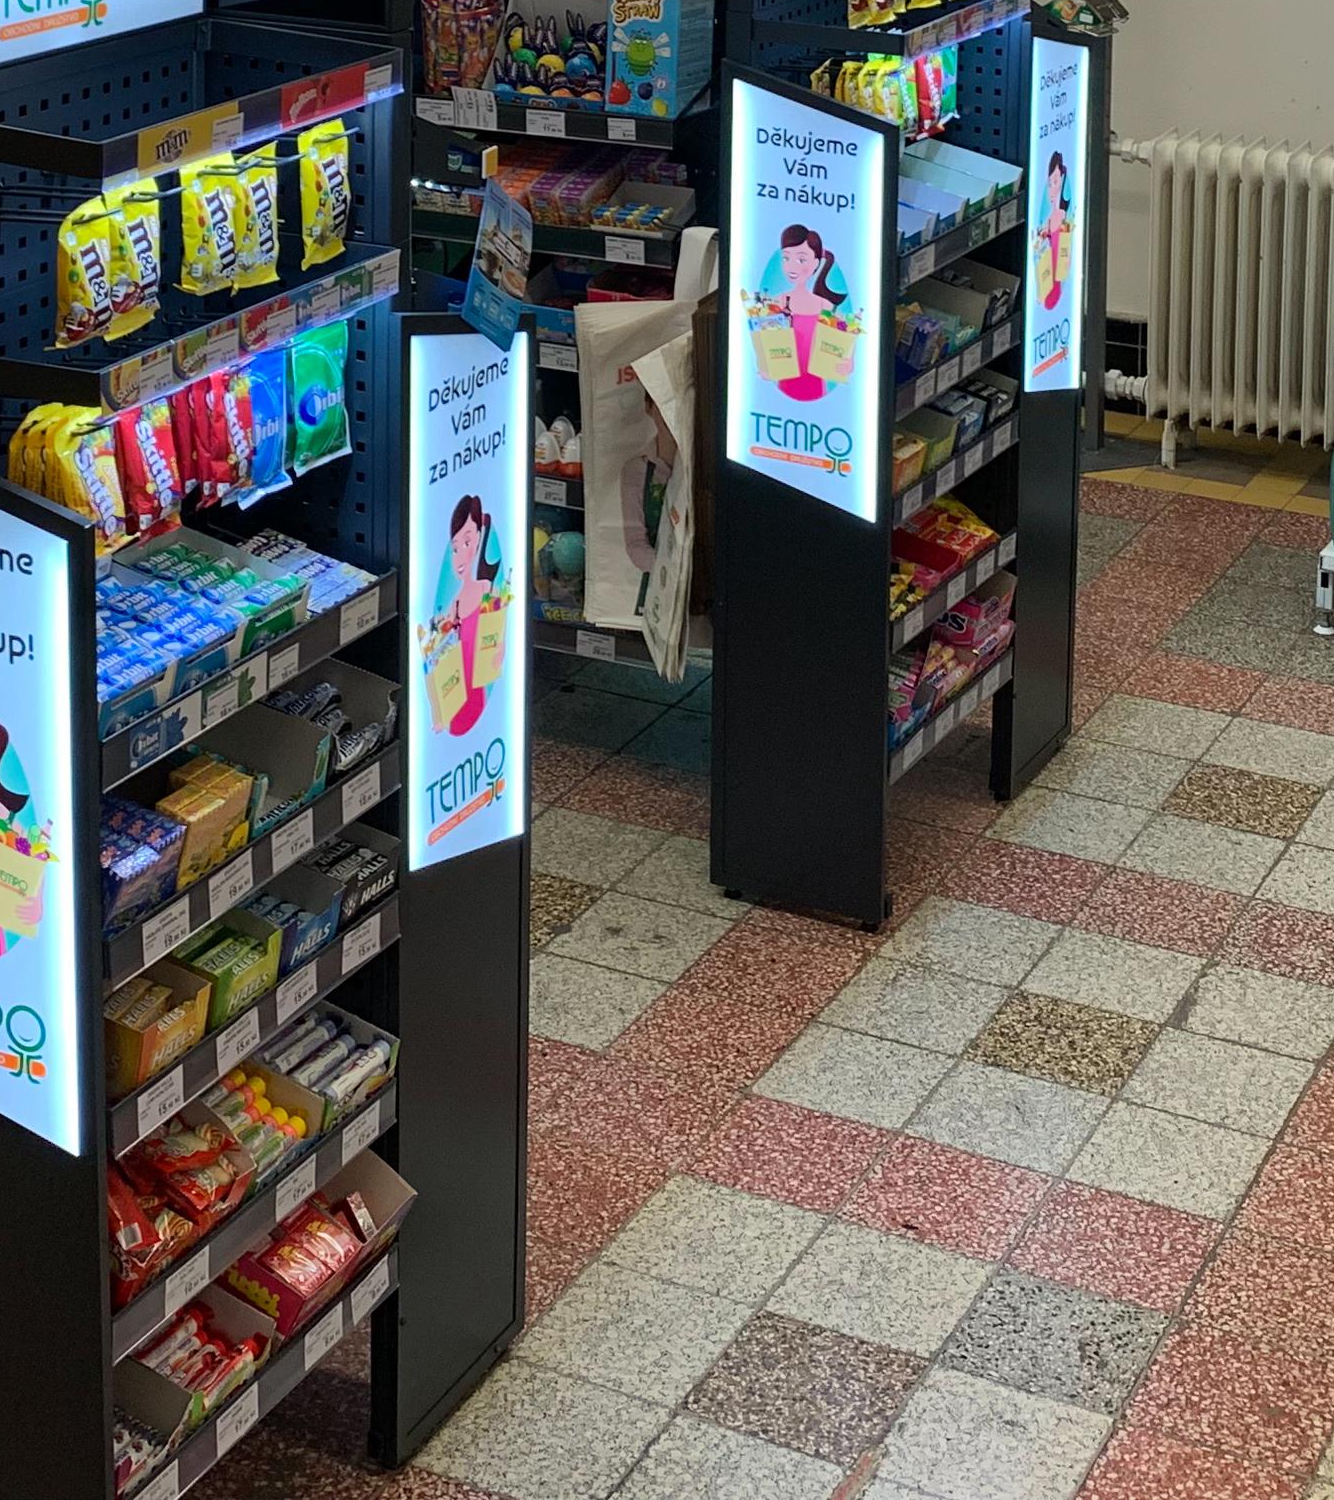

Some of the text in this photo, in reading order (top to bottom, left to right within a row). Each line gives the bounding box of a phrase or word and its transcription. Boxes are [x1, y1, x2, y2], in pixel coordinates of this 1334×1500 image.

[613, 1, 660, 23] STRAW
[757, 127, 858, 156] Děkujeme
[783, 157, 827, 180] Vám
[757, 183, 855, 213] za nákup!
[1033, 318, 1071, 364] TEMPO
[429, 357, 509, 412] Děkujeme
[451, 403, 486, 436] Vám
[750, 412, 853, 457] TEMPO
[429, 423, 506, 486] za nákup!
[426, 737, 505, 825] TEMPO
[359, 868, 395, 901] HALLS
[291, 922, 332, 966] HALLS
[227, 971, 272, 1009] HALLS
[154, 1027, 198, 1070] HALLS
